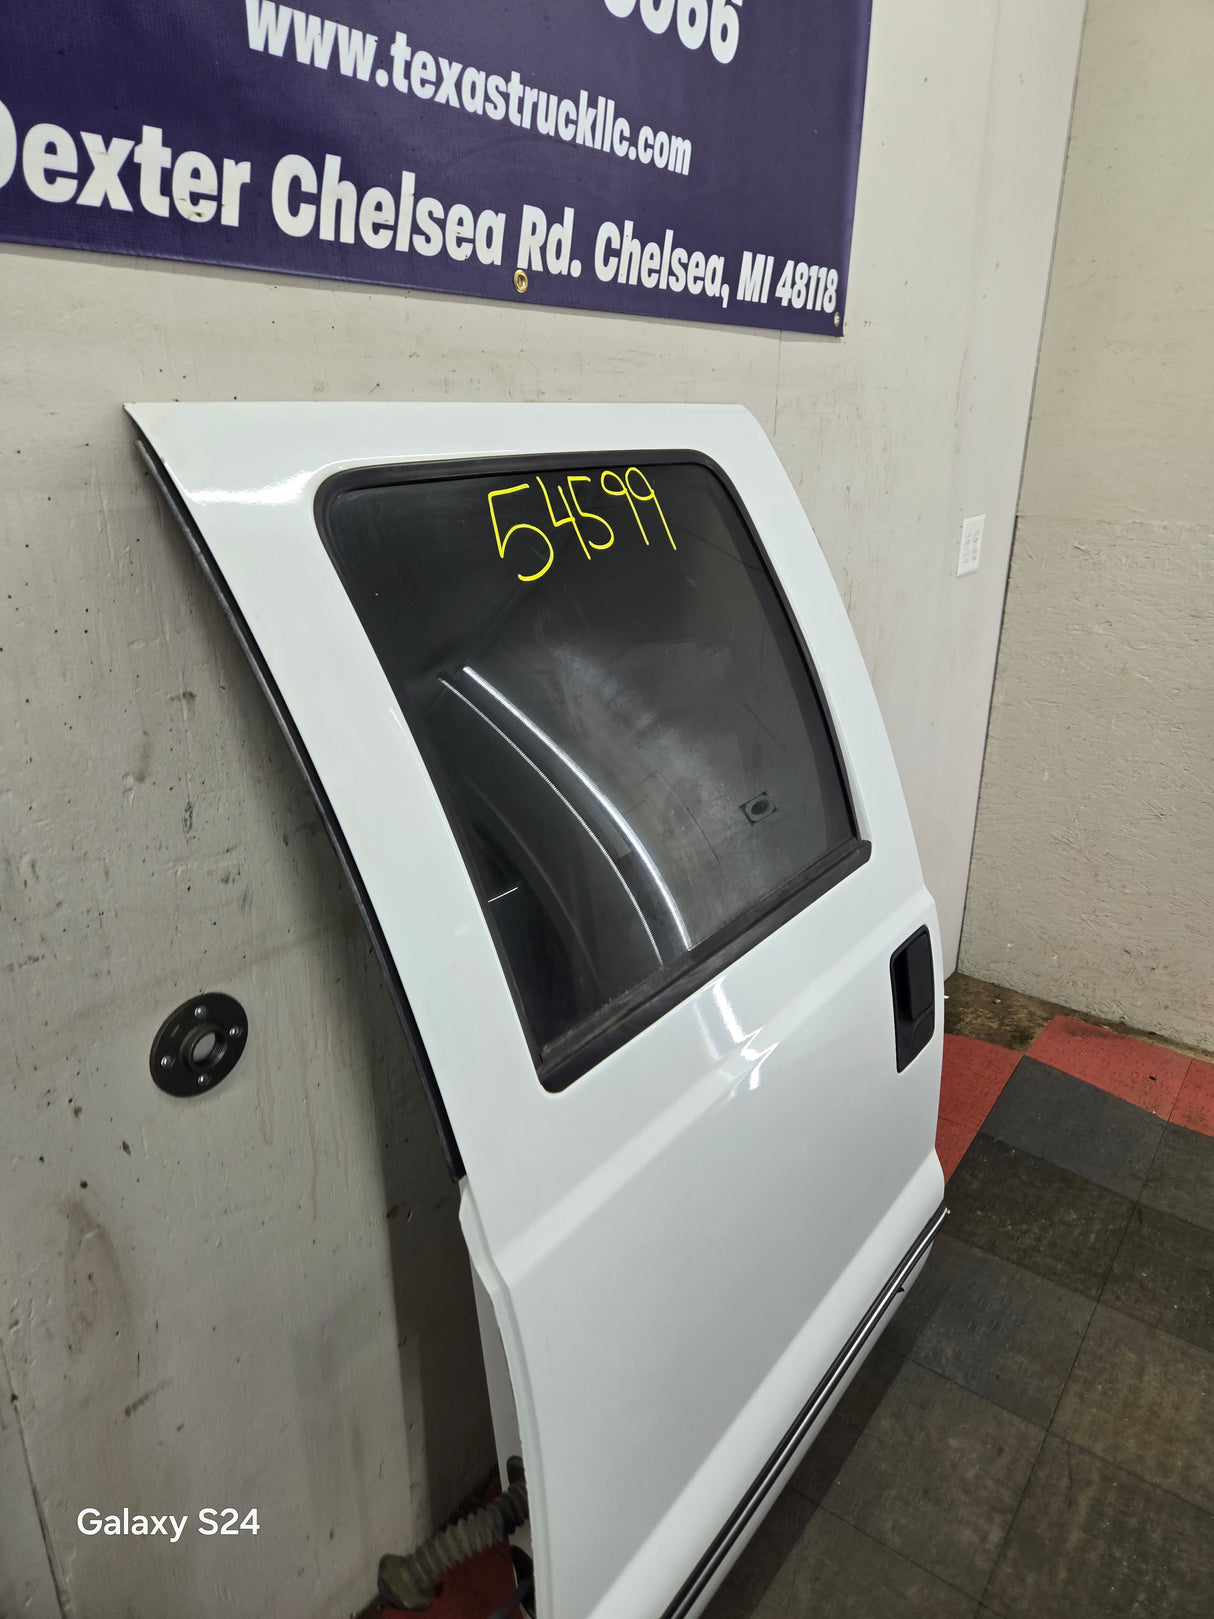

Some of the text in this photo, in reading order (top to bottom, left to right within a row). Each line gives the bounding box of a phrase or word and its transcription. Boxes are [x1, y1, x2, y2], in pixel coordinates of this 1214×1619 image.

[245, 0, 692, 176] www.texastruckllc.com
[271, 154, 507, 267] Chelsea
[516, 204, 583, 278] Rd.
[594, 220, 730, 309] Chelsea,
[736, 250, 775, 304] MI
[774, 259, 839, 314] 48118
[487, 466, 677, 582] 54599
